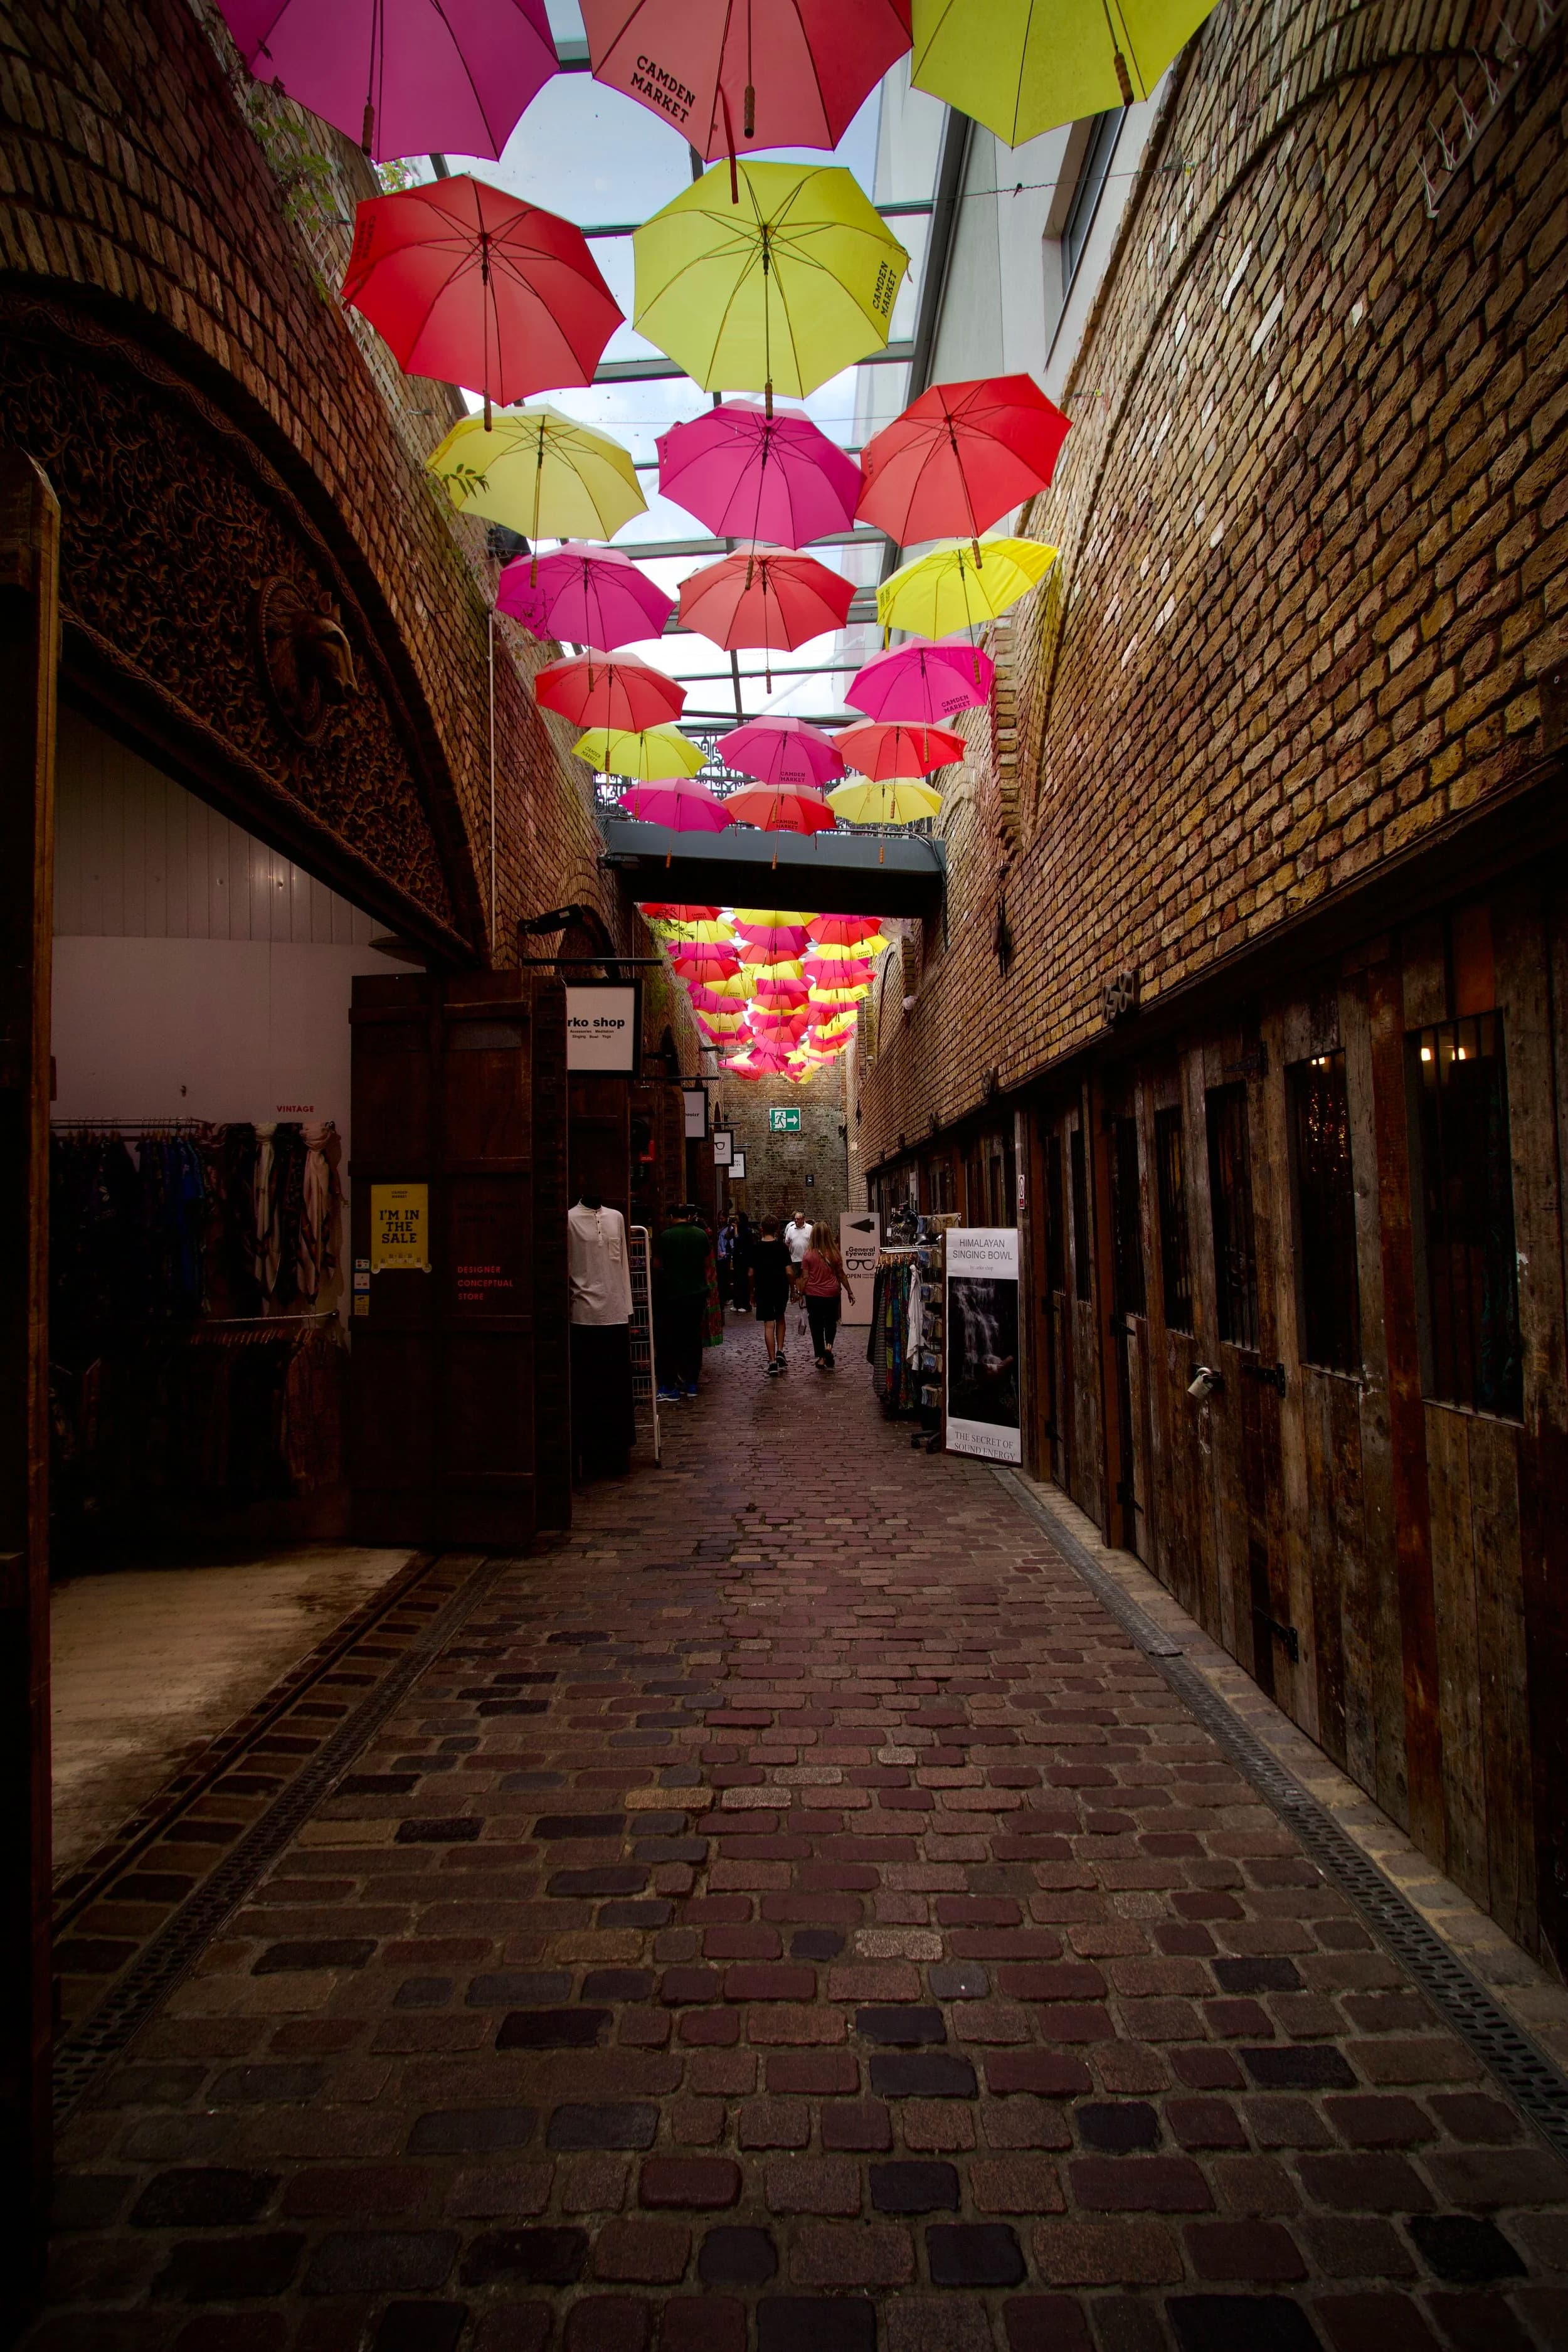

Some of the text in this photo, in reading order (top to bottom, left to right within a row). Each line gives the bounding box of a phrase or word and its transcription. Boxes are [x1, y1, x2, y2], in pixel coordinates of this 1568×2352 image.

[637, 55, 696, 108] CAMDEN
[630, 72, 689, 123] MARKET
[872, 260, 888, 309] CAMDEN
[881, 270, 897, 318] MARKET
[941, 694, 969, 707] CAMDEN
[944, 701, 970, 713] MARKET
[593, 1017, 625, 1029] shop
[379, 1210, 420, 1221] I'M IN
[386, 1221, 413, 1232] THE
[381, 1233, 417, 1244] SALE
[959, 1239, 1005, 1248] HIMALAYAN
[953, 1249, 1013, 1260] SINGING BOWL
[457, 1266, 501, 1274] DESIGNER
[457, 1279, 514, 1287] CONCEPTUAL
[457, 1292, 484, 1300] STORE
[955, 1431, 1014, 1449] THE SECRET OF
[955, 1442, 1015, 1461] SOUND ENERGY
